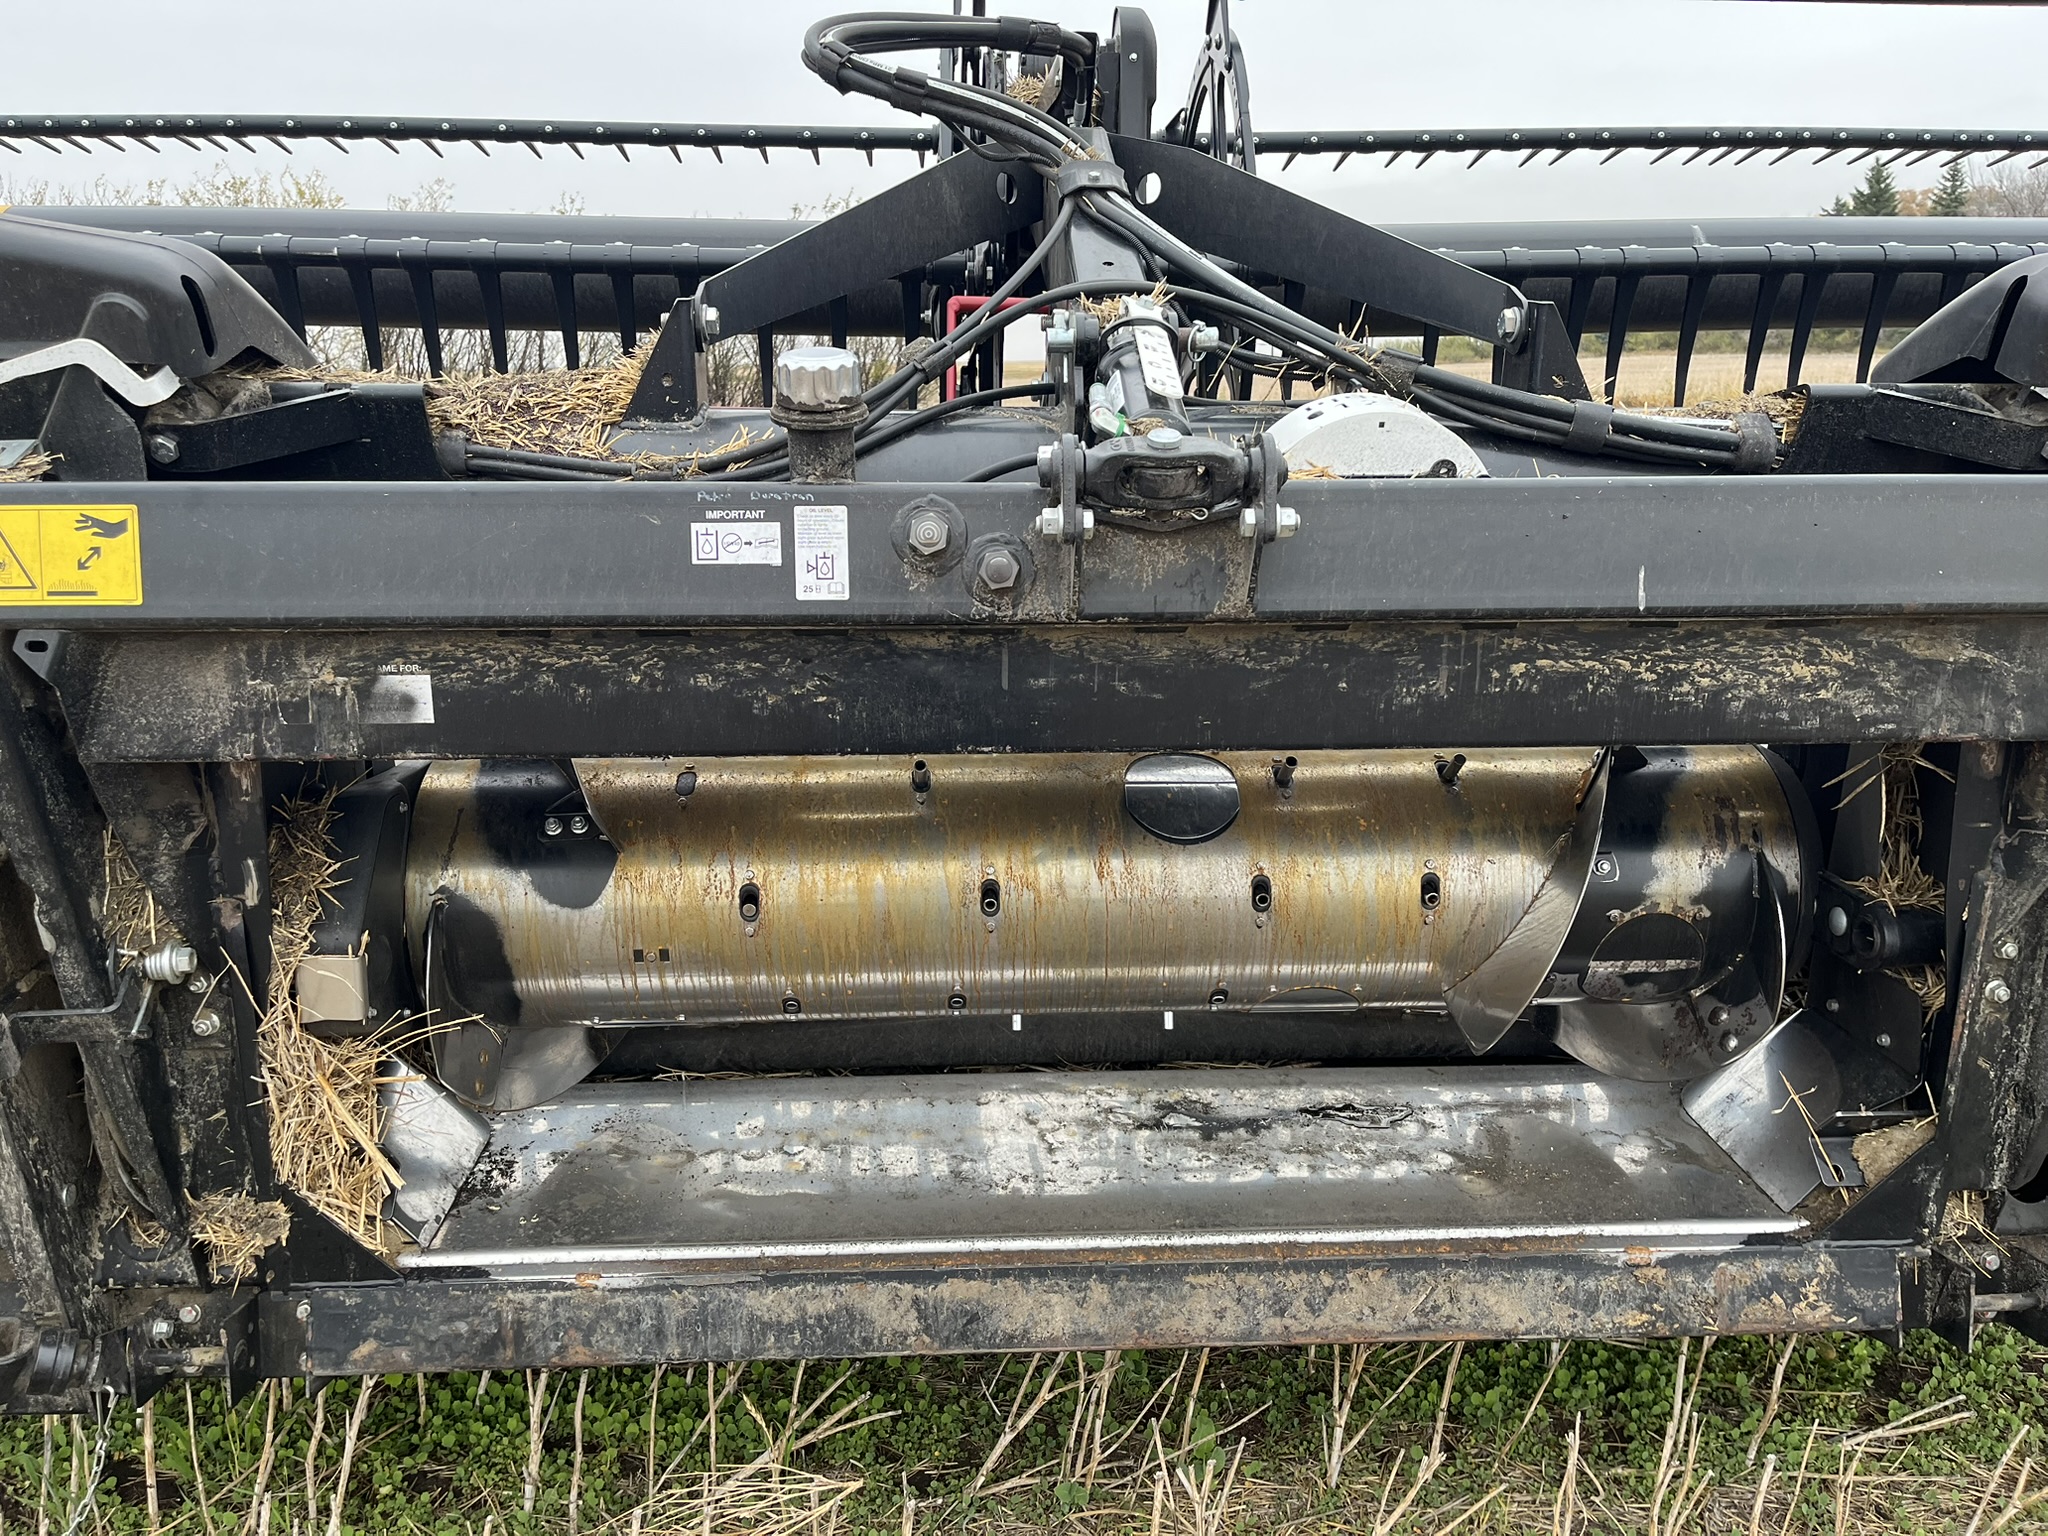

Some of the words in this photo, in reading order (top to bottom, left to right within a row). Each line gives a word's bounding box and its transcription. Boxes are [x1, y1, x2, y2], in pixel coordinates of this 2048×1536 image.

[705, 509, 766, 519] IMPORTANT
[803, 584, 814, 593] 25
[399, 664, 422, 673] FOR:
